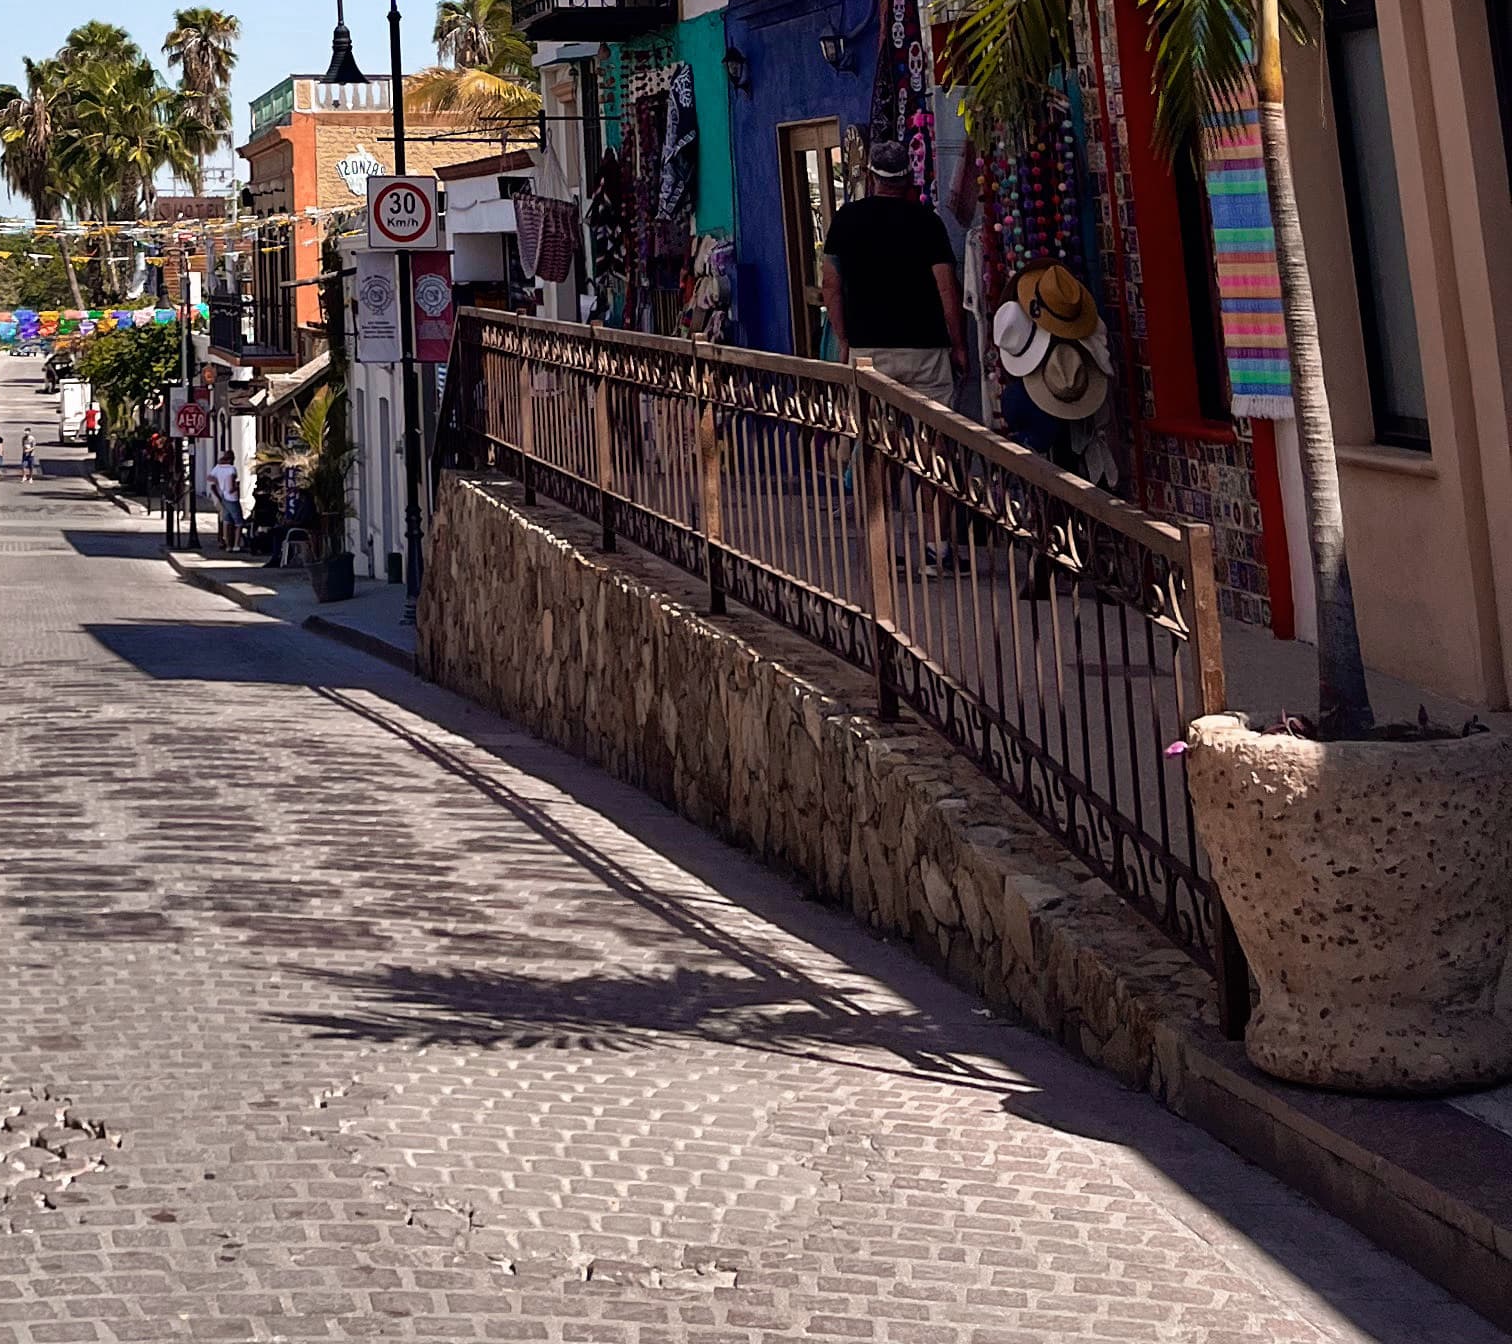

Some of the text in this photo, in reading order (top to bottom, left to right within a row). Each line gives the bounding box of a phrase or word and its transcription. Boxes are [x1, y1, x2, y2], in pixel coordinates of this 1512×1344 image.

[389, 191, 416, 215] 30
[386, 217, 419, 228] Km/h
[178, 413, 204, 427] ALTO
